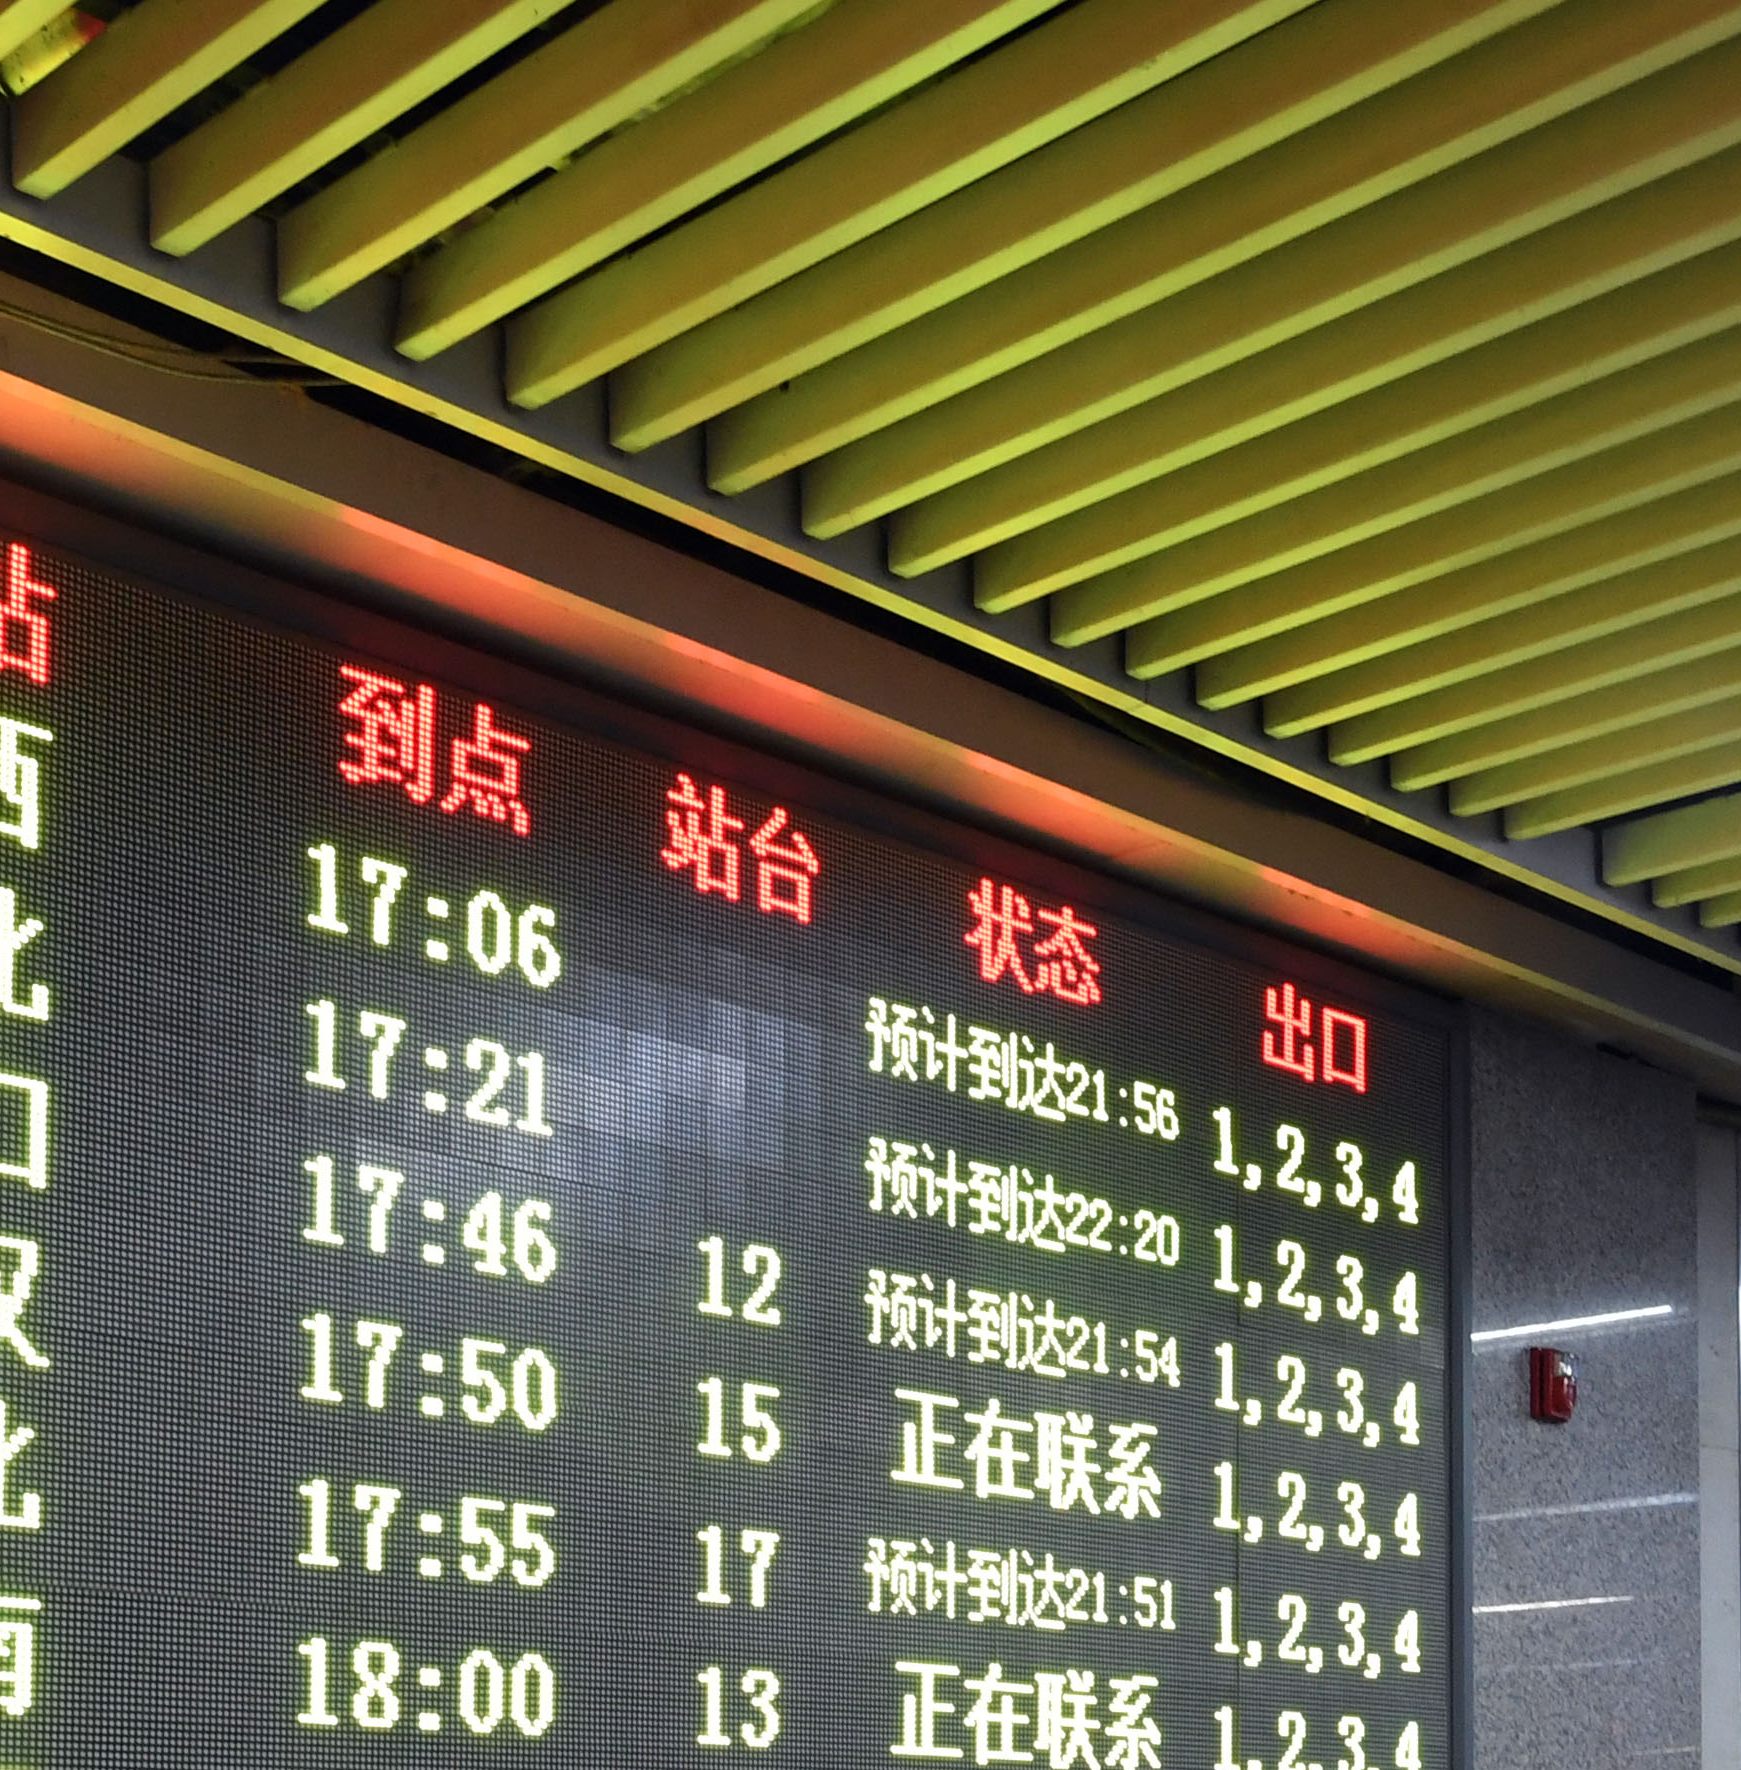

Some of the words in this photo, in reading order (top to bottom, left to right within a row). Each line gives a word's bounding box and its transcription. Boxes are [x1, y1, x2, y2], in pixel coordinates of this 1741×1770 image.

[337, 664, 532, 838] 到点
[659, 772, 822, 926] 站台
[962, 876, 1103, 1007] 状态
[1261, 981, 1368, 1094] 出口
[304, 998, 554, 1139] 17:21
[1213, 1223, 1420, 1336] 1,2,3,4
[306, 842, 562, 989] 17:06
[1211, 1106, 1420, 1226] 1,2,3,4
[300, 1312, 558, 1432] 17:50
[696, 1376, 782, 1463] 15
[889, 1387, 1163, 1521] 正在联系
[1212, 1460, 1422, 1561] 1,2,3,4
[302, 1154, 558, 1284] 17:46
[697, 1234, 782, 1326] 12
[1213, 1341, 1421, 1449] 1,2,3,4
[296, 1636, 555, 1737] 18:00
[696, 1665, 781, 1749] 13
[297, 1478, 557, 1588] 17:55
[695, 1524, 781, 1609] 17
[1212, 1586, 1422, 1680] 1,2,3,4
